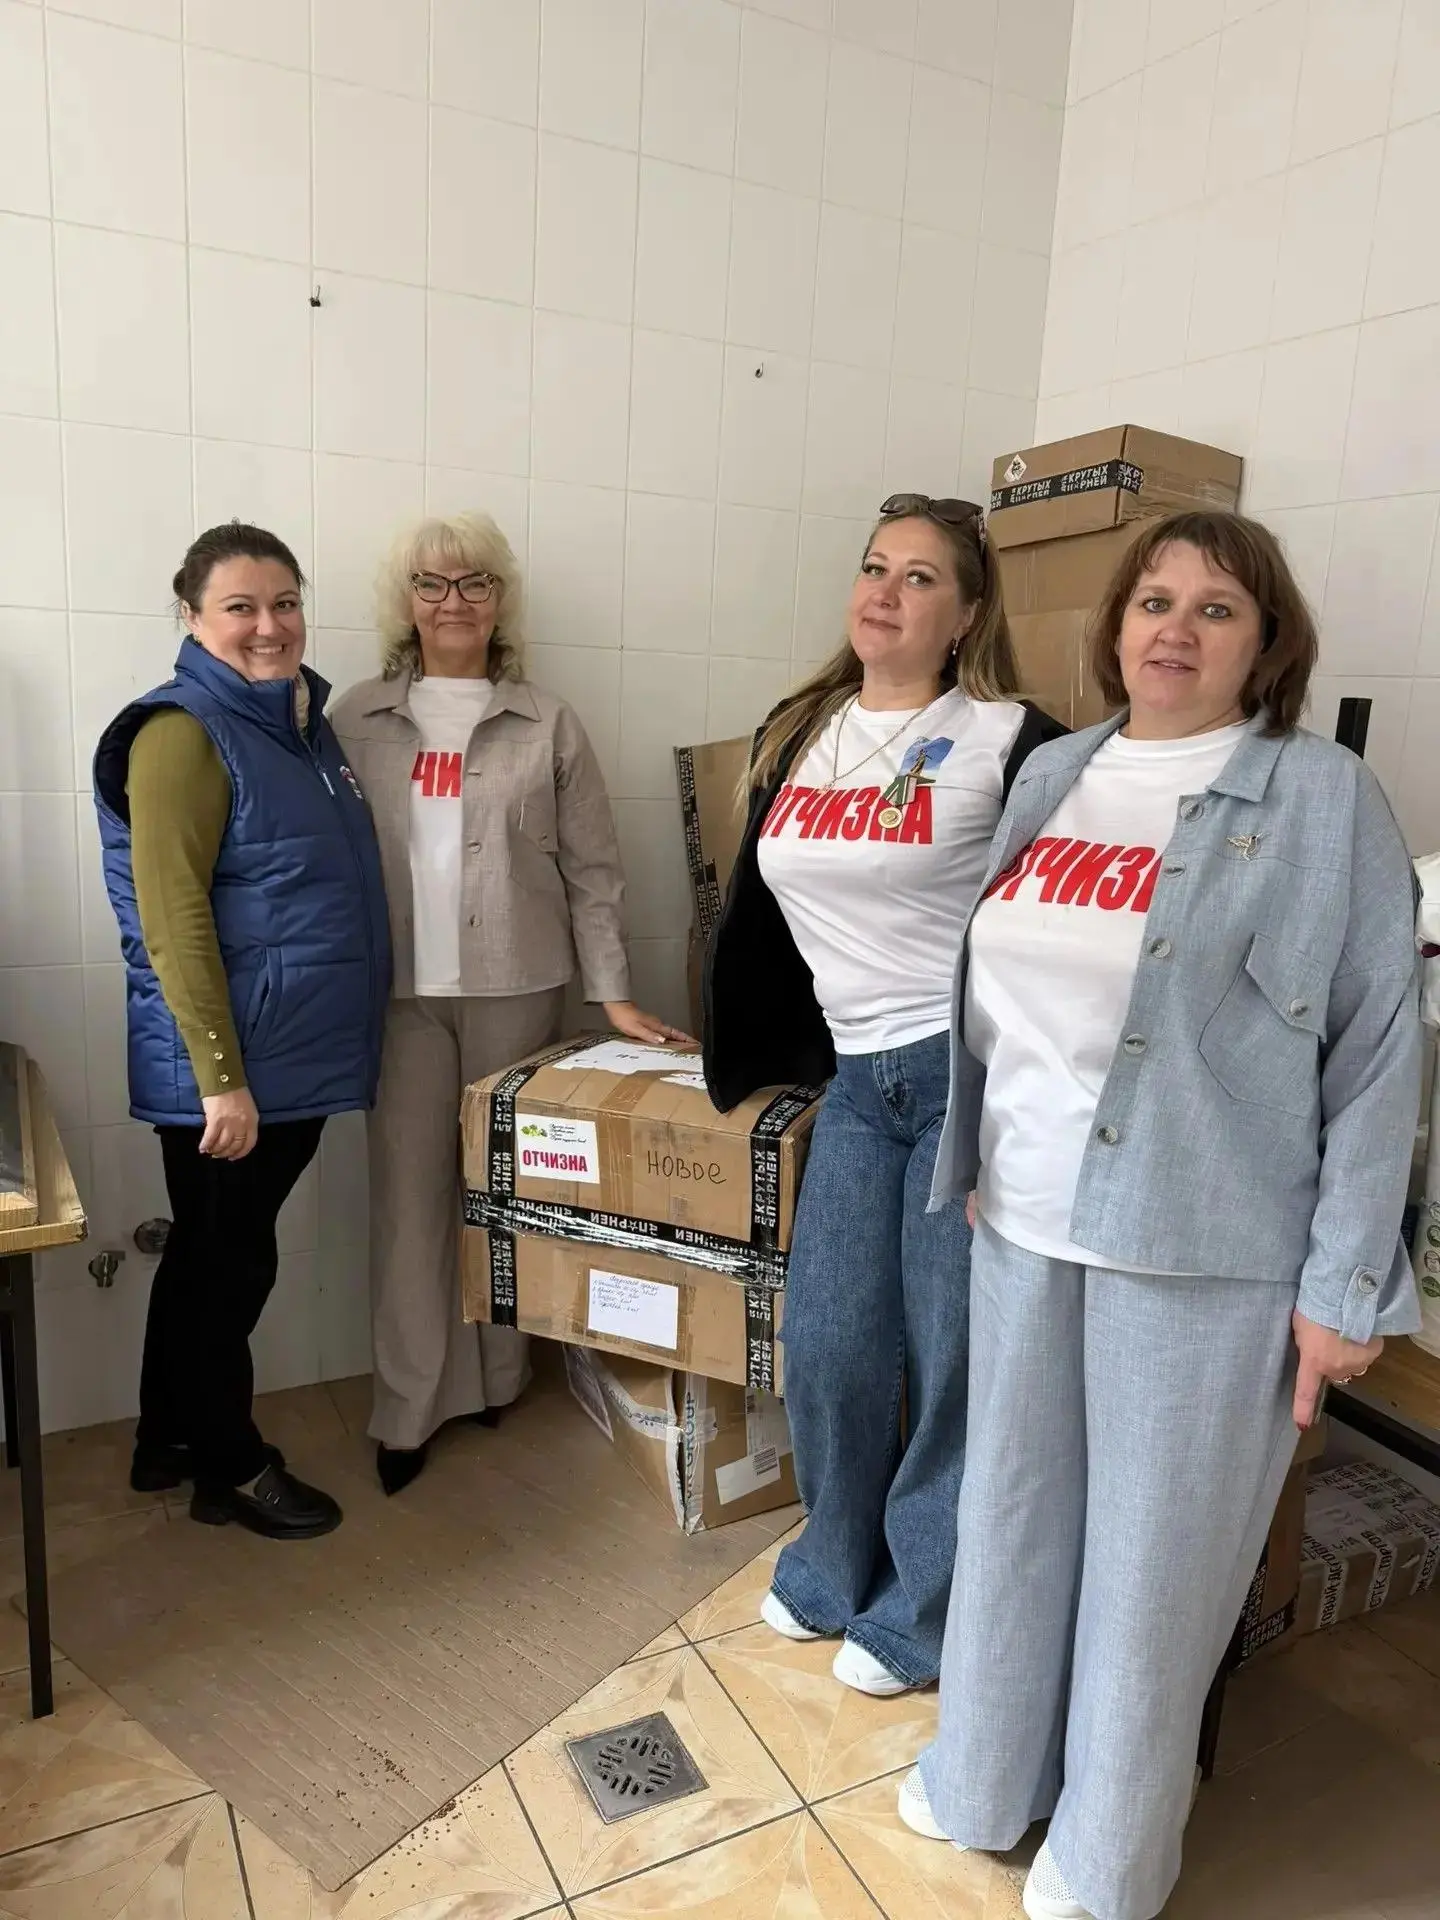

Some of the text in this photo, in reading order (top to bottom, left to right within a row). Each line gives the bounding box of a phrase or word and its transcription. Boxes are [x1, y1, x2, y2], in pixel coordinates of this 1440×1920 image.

[1069, 464, 1108, 484] КРУТЫХ
[1016, 479, 1051, 496] КРУТЫХ
[523, 1150, 588, 1172] ОТЧИЗНА
[754, 1150, 766, 1214] КРУТЫХ
[492, 1238, 504, 1295] КРУТЫХ
